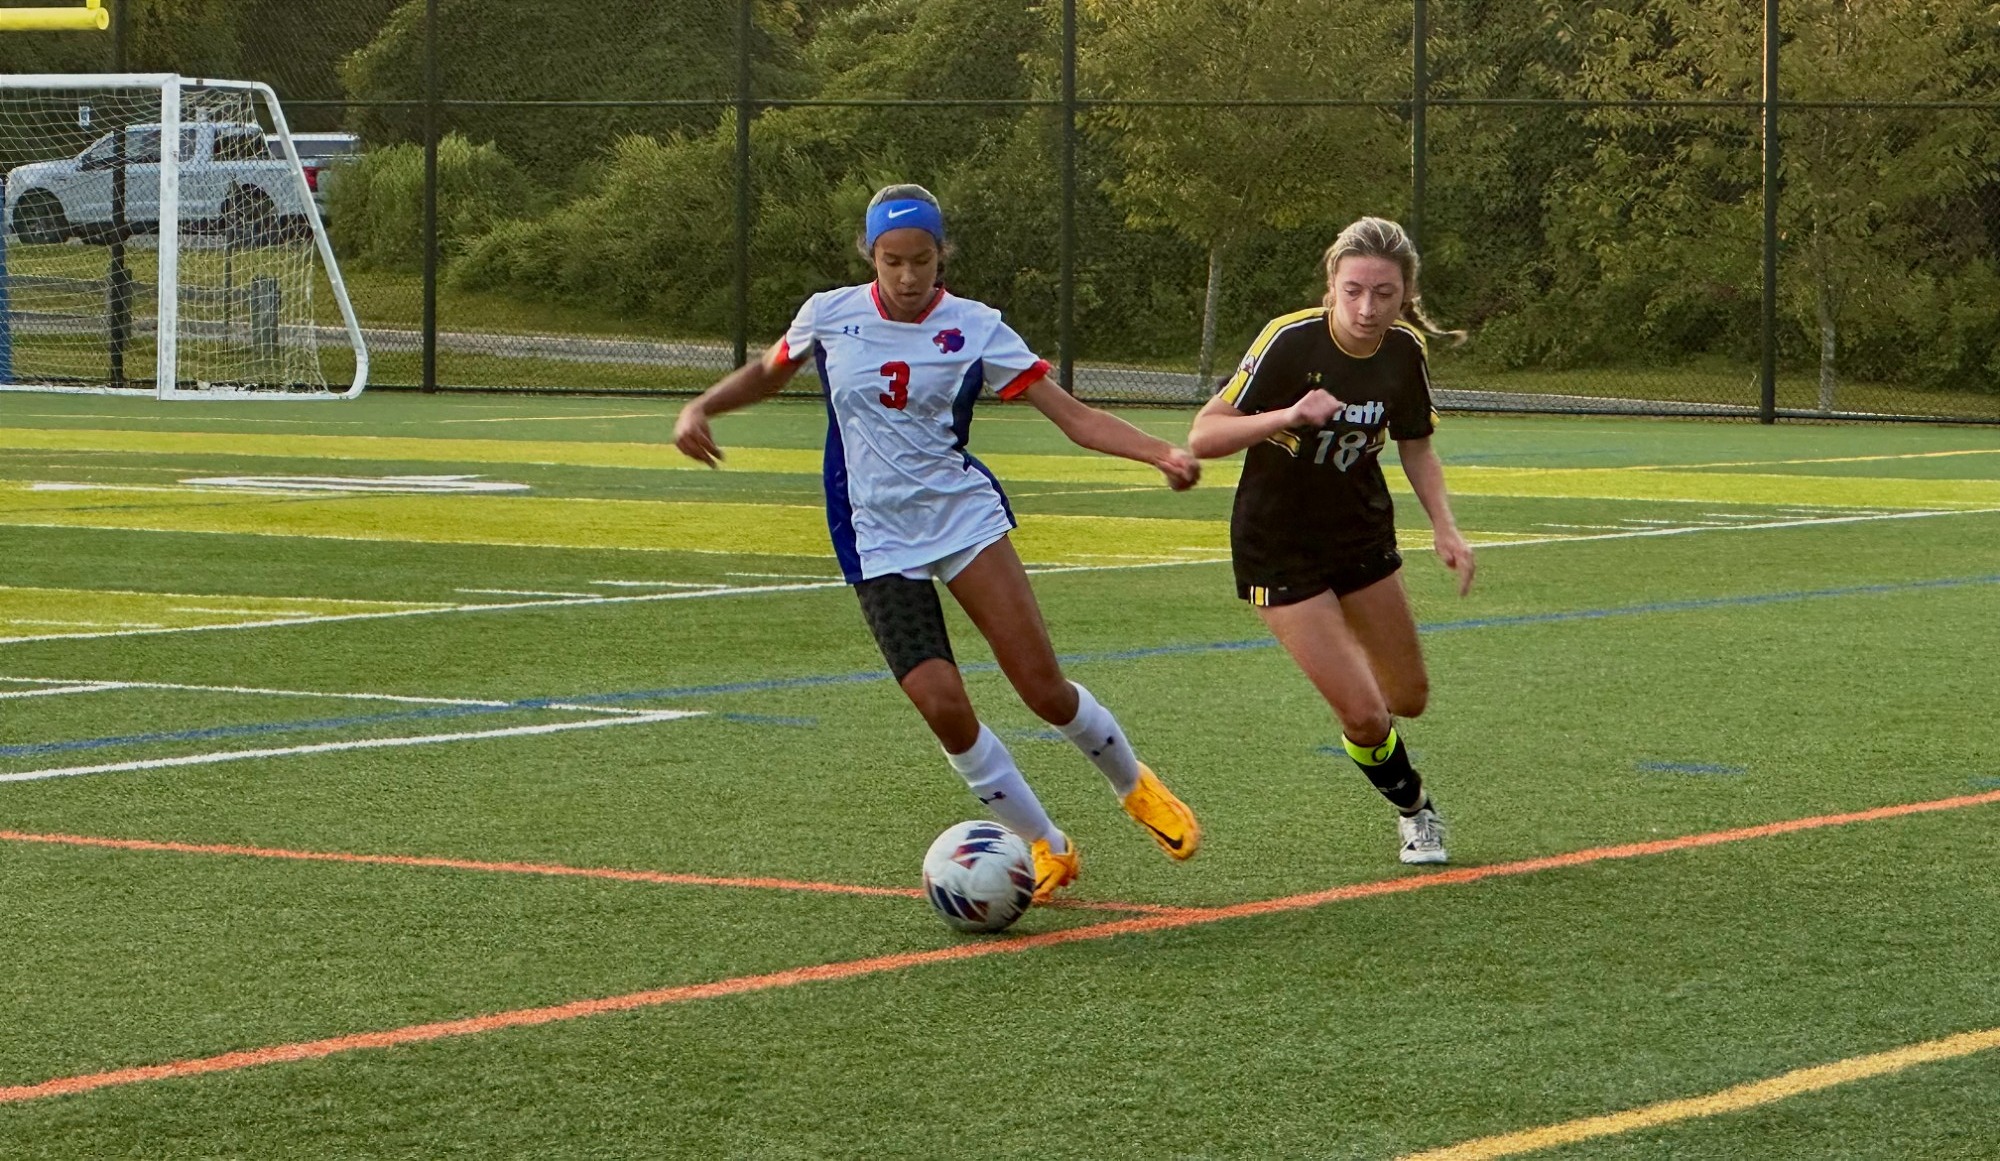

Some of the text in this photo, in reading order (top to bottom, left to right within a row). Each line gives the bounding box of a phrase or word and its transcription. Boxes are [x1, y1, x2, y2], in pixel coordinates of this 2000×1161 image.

[879, 361, 910, 411] 3
[1333, 400, 1385, 424] ratt
[1313, 430, 1367, 472] 18
[1371, 742, 1390, 763] C
